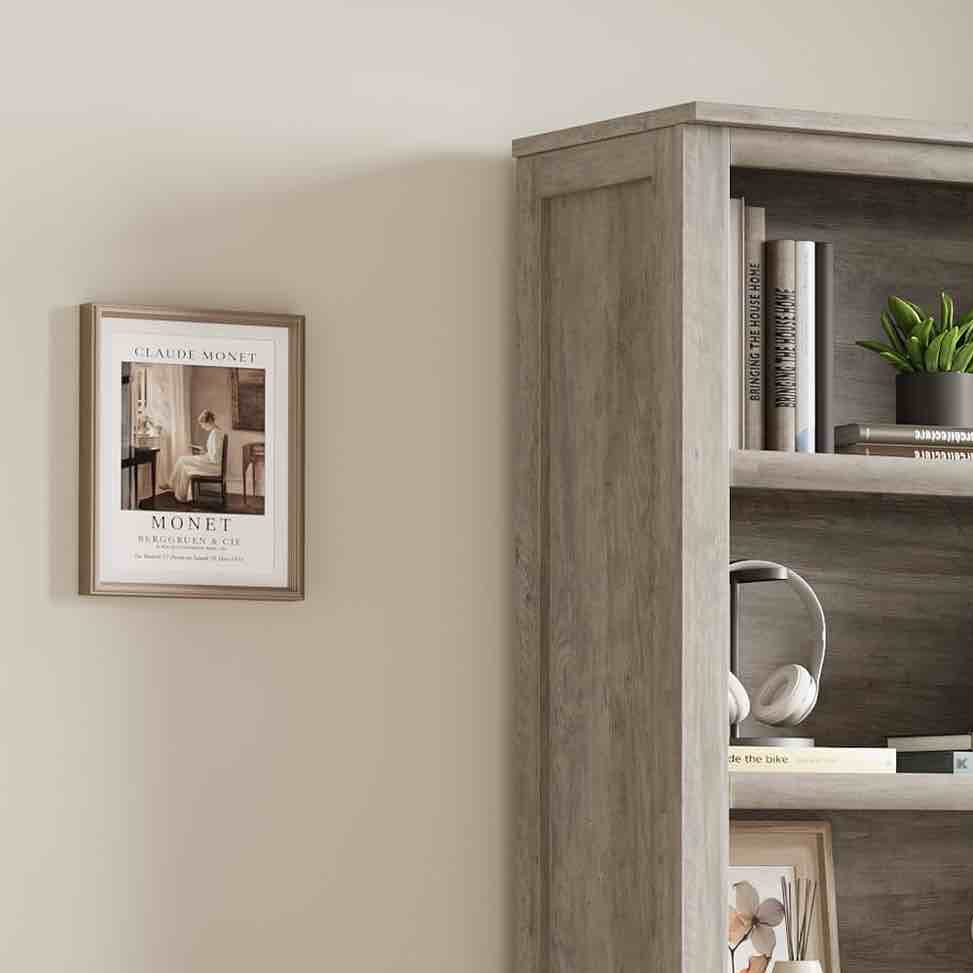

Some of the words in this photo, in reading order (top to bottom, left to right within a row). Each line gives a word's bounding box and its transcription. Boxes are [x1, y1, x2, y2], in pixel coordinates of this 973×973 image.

[750, 264, 760, 292] HOME
[750, 294, 760, 327] HOUSE
[750, 330, 760, 351] THE
[776, 317, 796, 345] HOUSE
[134, 347, 193, 360] CLAUDE
[201, 351, 256, 363] MONET
[750, 353, 760, 401] BRINGING
[152, 515, 231, 532] MONET
[745, 753, 762, 763] the
[766, 753, 789, 763] bike
